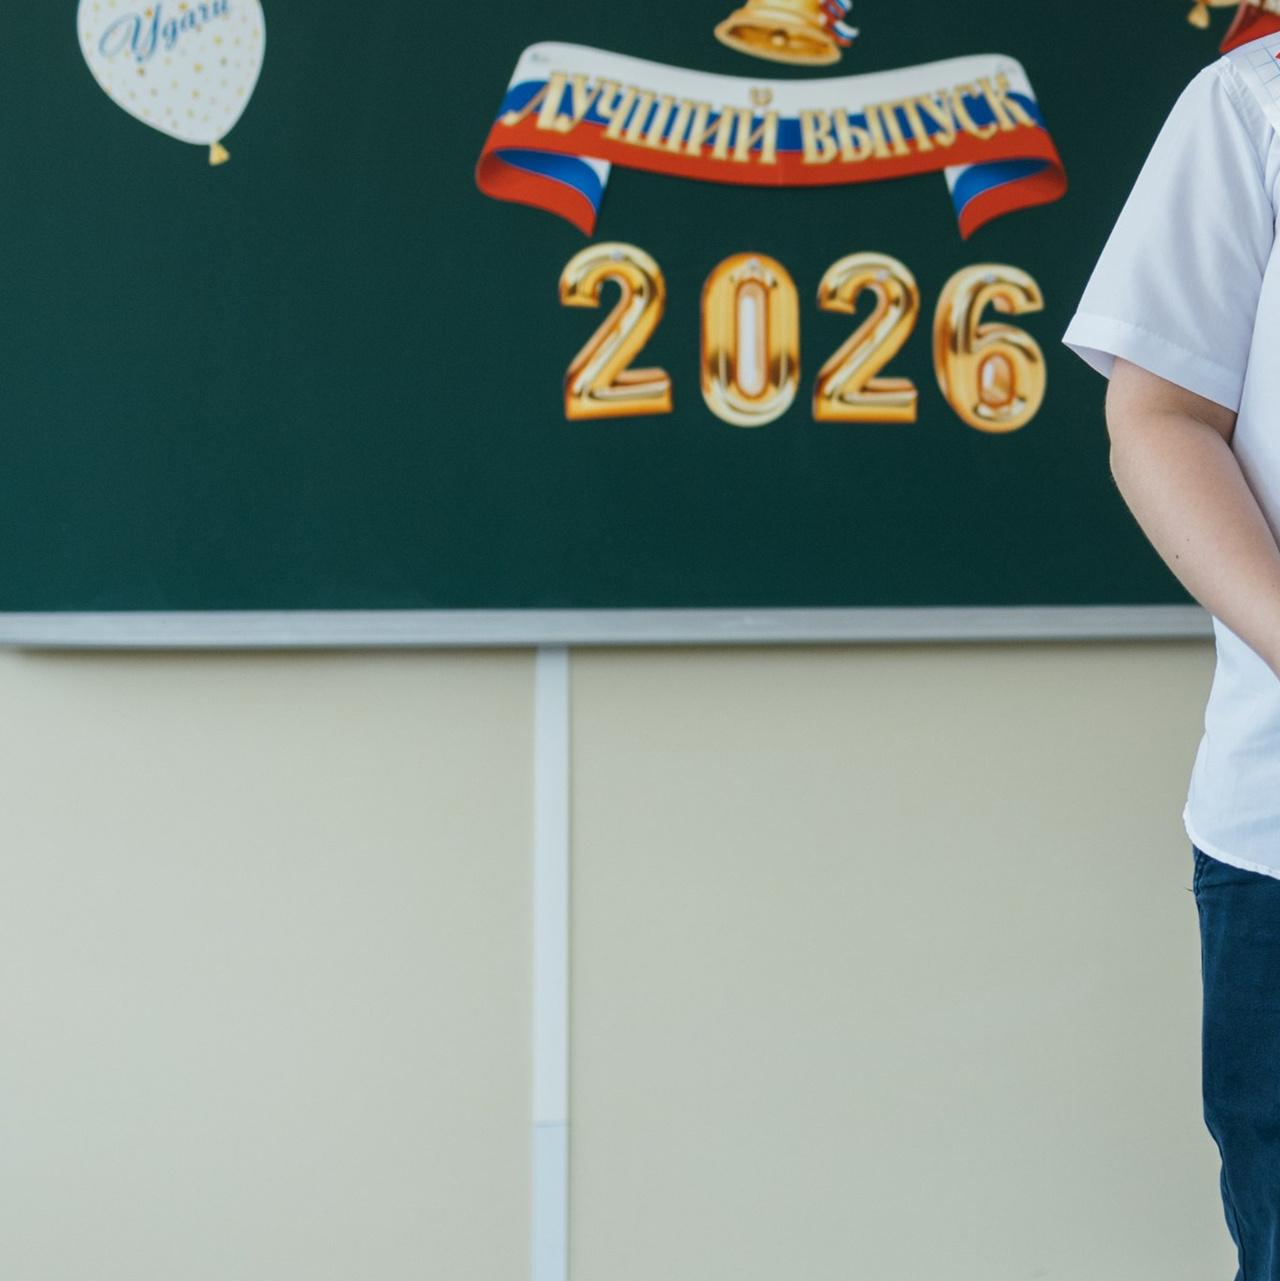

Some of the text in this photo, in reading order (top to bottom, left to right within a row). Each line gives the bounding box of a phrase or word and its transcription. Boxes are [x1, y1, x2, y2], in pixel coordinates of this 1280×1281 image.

[502, 72, 1037, 166] ЛУЧШИЙ ВЫПУСК
[558, 242, 1047, 432] 2026
